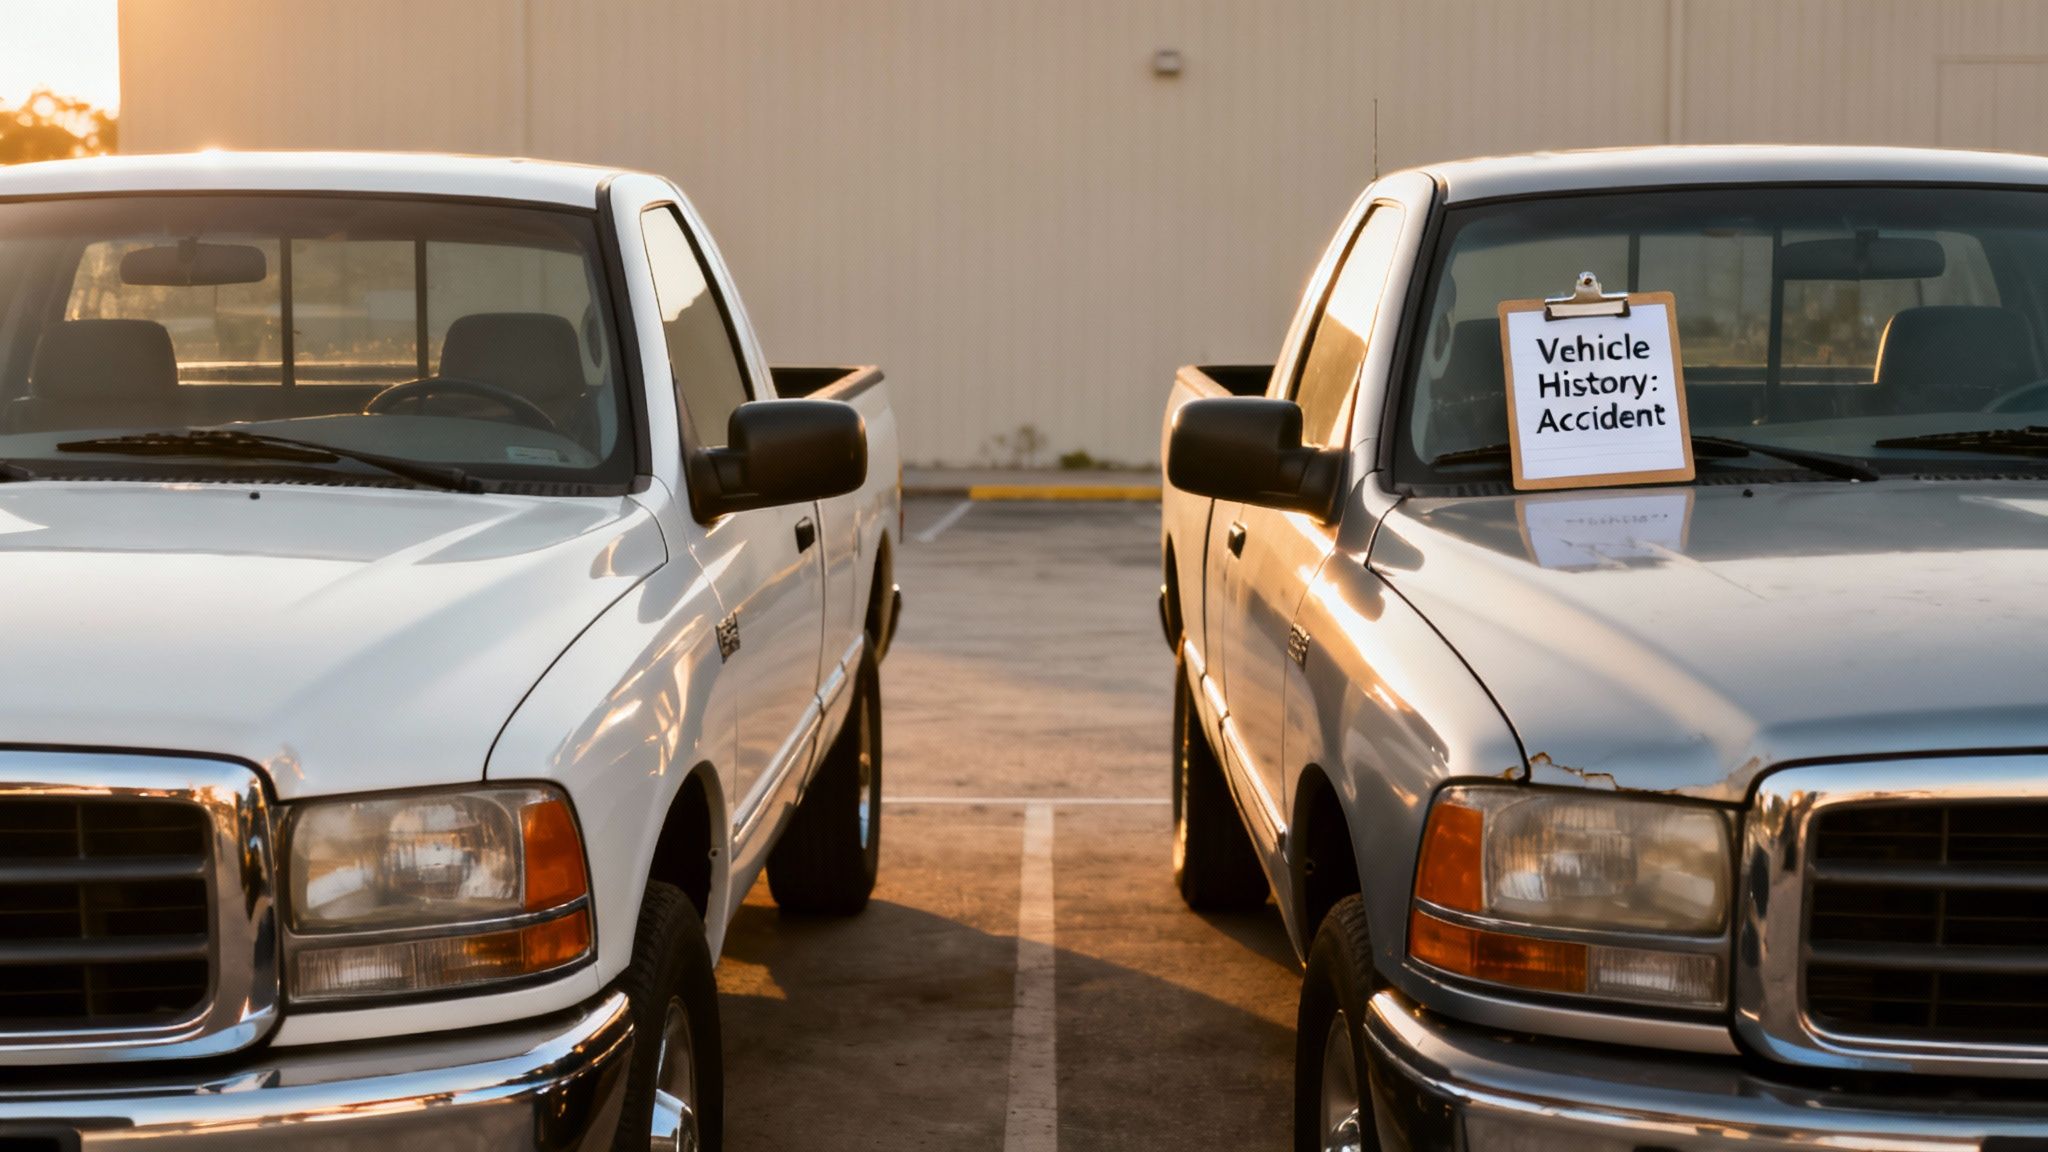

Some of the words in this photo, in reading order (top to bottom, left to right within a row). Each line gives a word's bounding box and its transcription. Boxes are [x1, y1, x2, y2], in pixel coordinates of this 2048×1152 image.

[1536, 333, 1650, 364] Vehicle
[1538, 370, 1658, 400] History:
[1536, 402, 1666, 434] Accident
